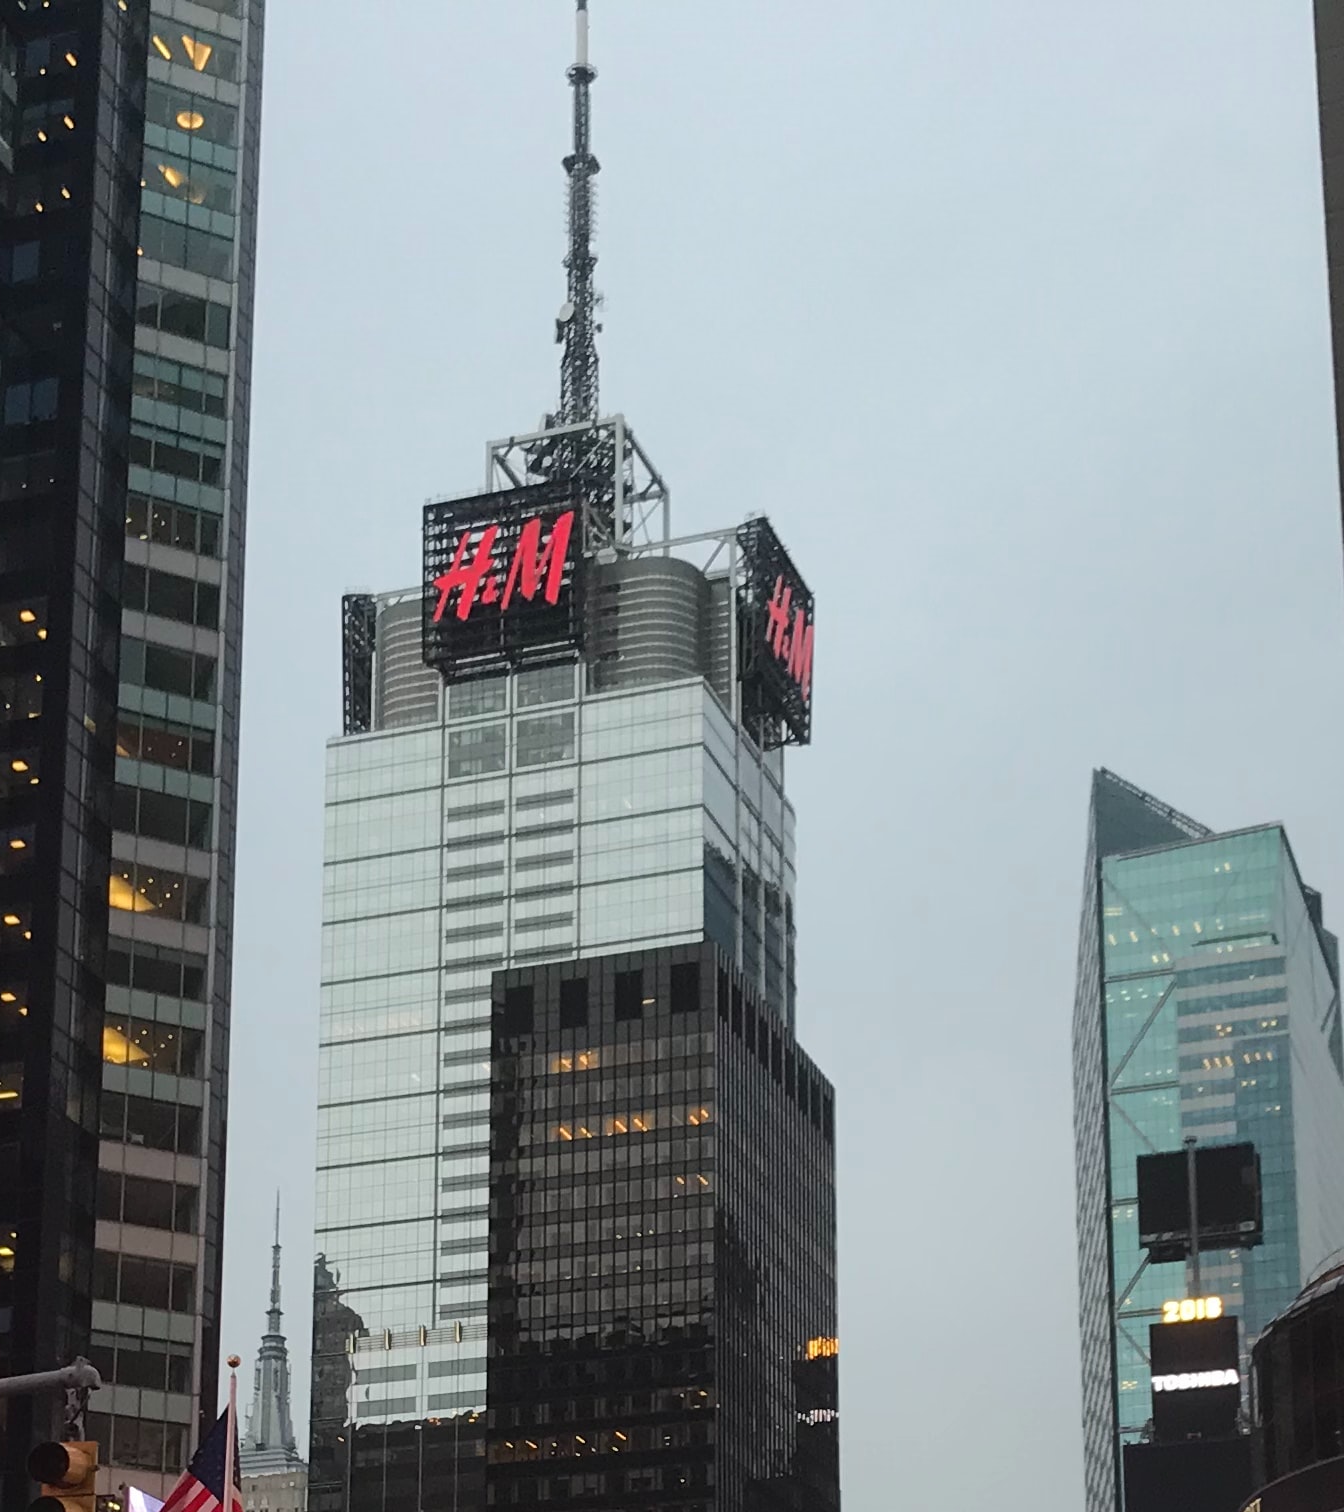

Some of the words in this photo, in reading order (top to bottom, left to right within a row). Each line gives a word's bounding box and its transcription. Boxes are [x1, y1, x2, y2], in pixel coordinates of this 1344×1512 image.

[432, 510, 575, 622] H&M
[765, 574, 815, 702] H&M
[1151, 1368, 1240, 1392] TOSHIBA
